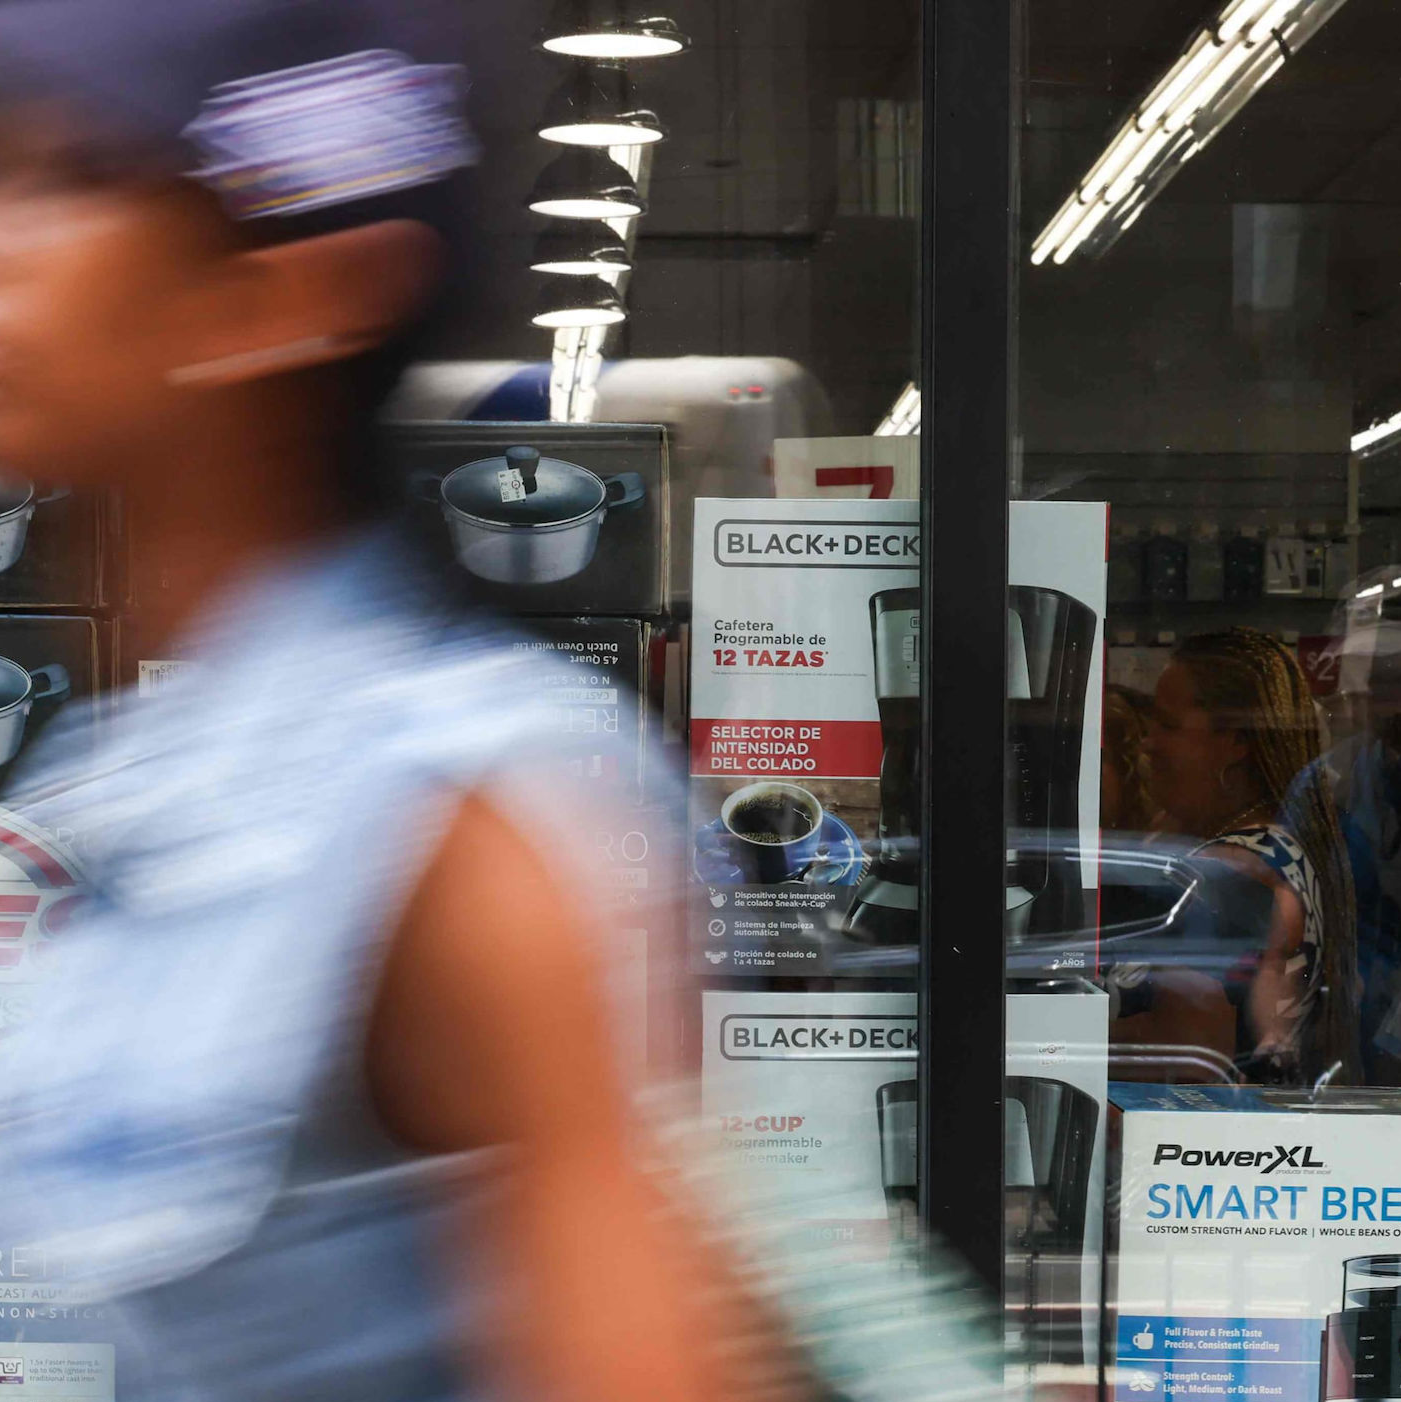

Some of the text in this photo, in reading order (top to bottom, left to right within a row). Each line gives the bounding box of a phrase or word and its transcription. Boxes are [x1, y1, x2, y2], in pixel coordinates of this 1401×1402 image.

[714, 620, 773, 631] Cafetera
[714, 633, 826, 646] Programable de
[713, 650, 824, 667] 12 TAZAS
[711, 726, 821, 739] SELECTOR DE
[711, 742, 808, 755] INTENSIDAD
[711, 757, 816, 770] DEL COLADO
[1153, 1144, 1324, 1174] PowerXL
[1147, 1183, 1307, 1220] SMART
[1147, 1225, 1307, 1236] CUSTOM STRENGTH AND FLAVOR
[1319, 1228, 1356, 1236] WHOLE
[1358, 1229, 1391, 1237] BEANS
[1163, 1372, 1235, 1382] Strength Control:
